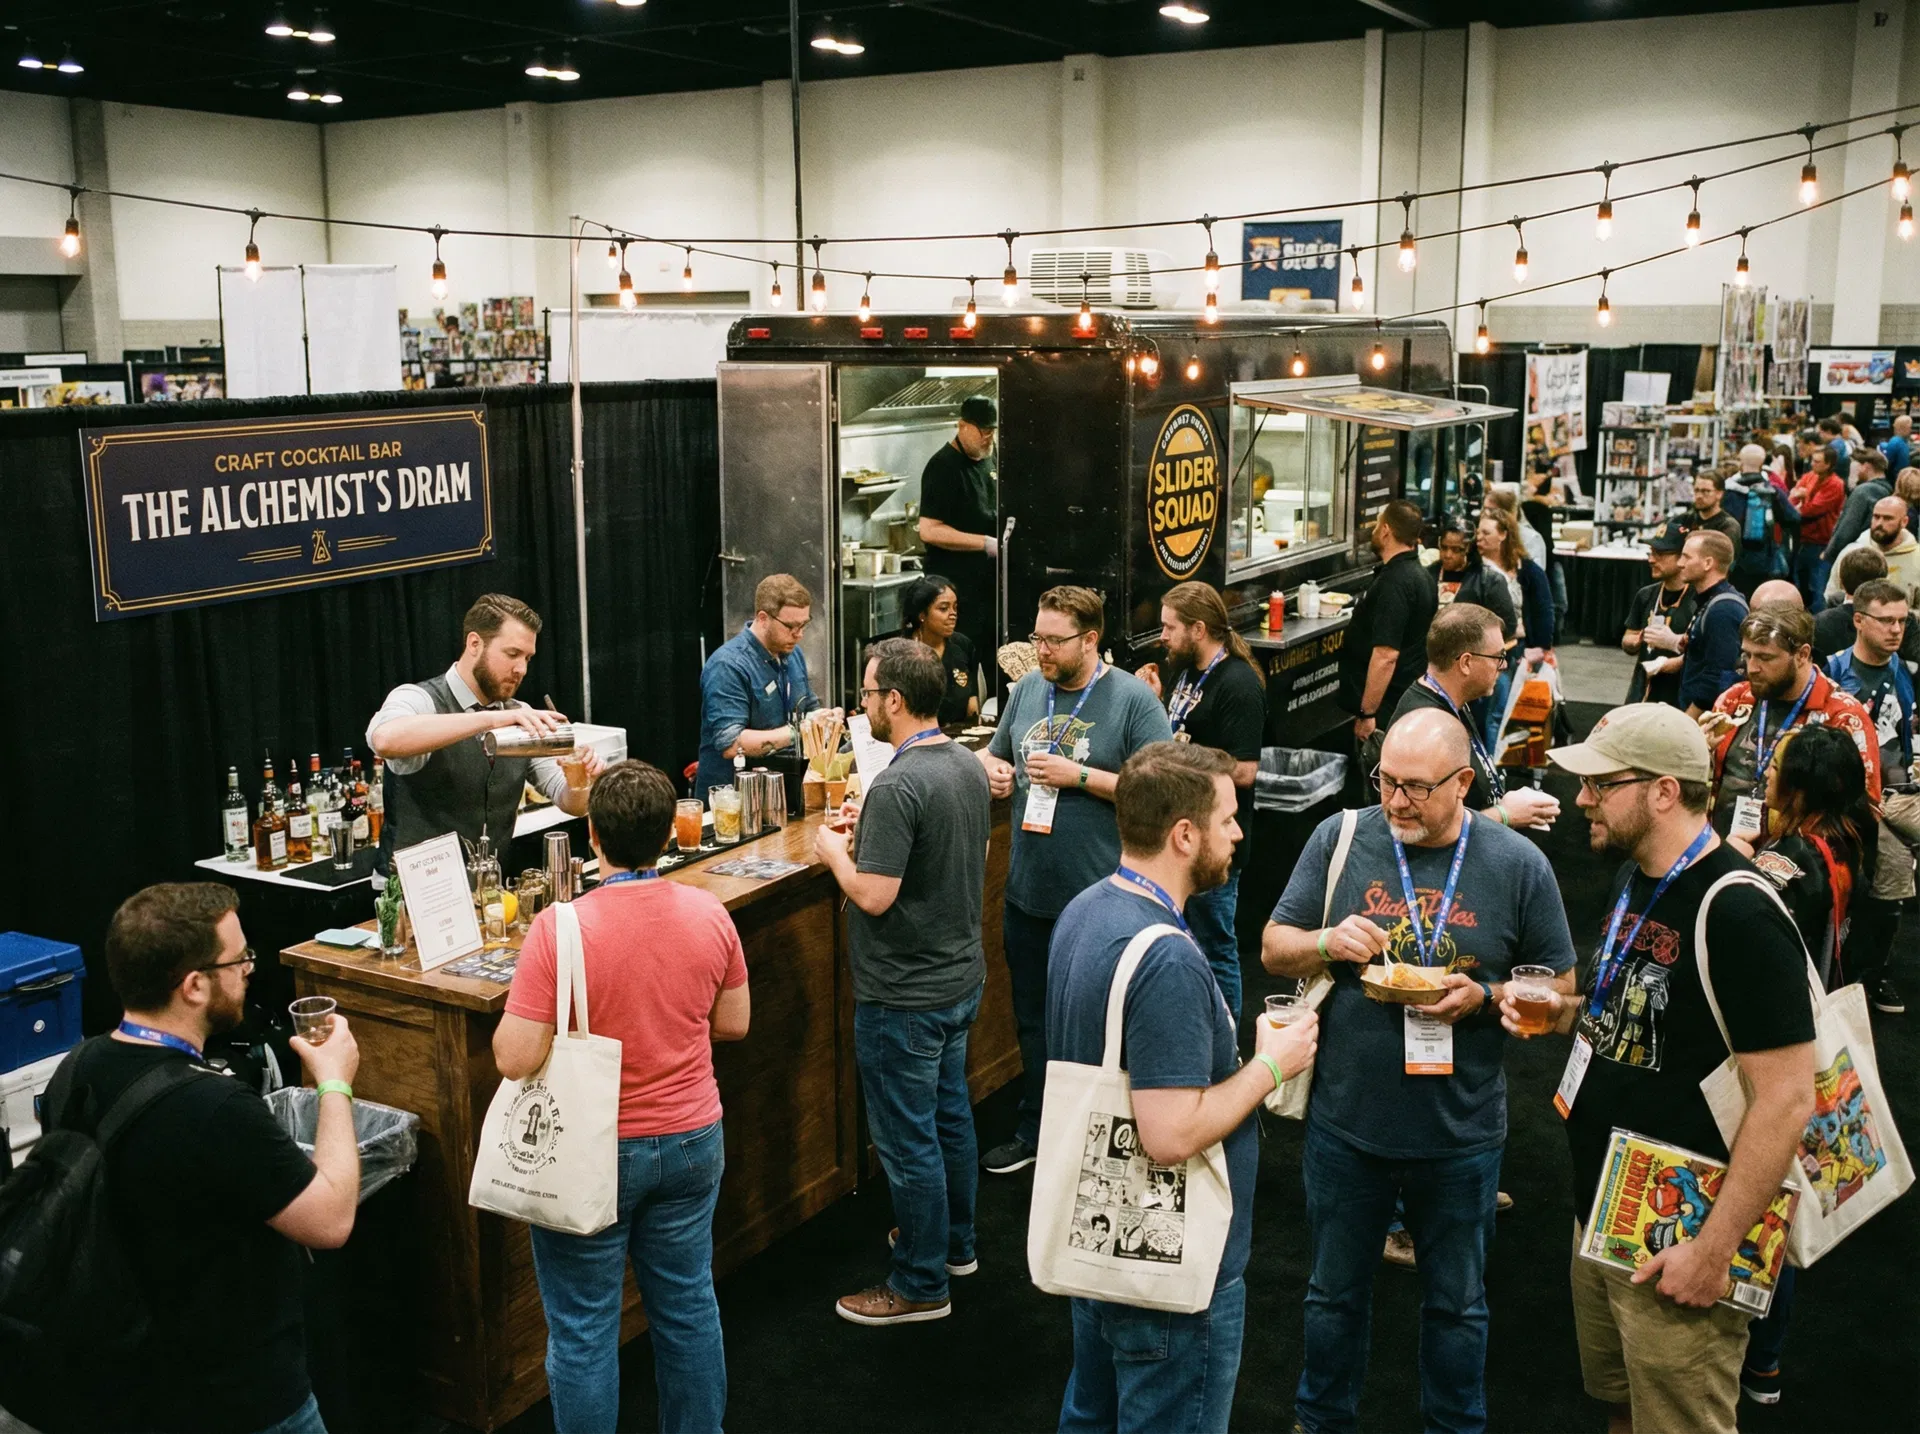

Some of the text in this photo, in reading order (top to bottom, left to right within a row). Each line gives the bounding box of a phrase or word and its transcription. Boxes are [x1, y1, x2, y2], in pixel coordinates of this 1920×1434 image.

[215, 441, 402, 472] CRAFT COCKTAIL BAR
[1154, 455, 1215, 495] SLIDER
[122, 461, 472, 542] THE ALCHEMIST'S DRAM
[1154, 490, 1215, 532] SQUAD
